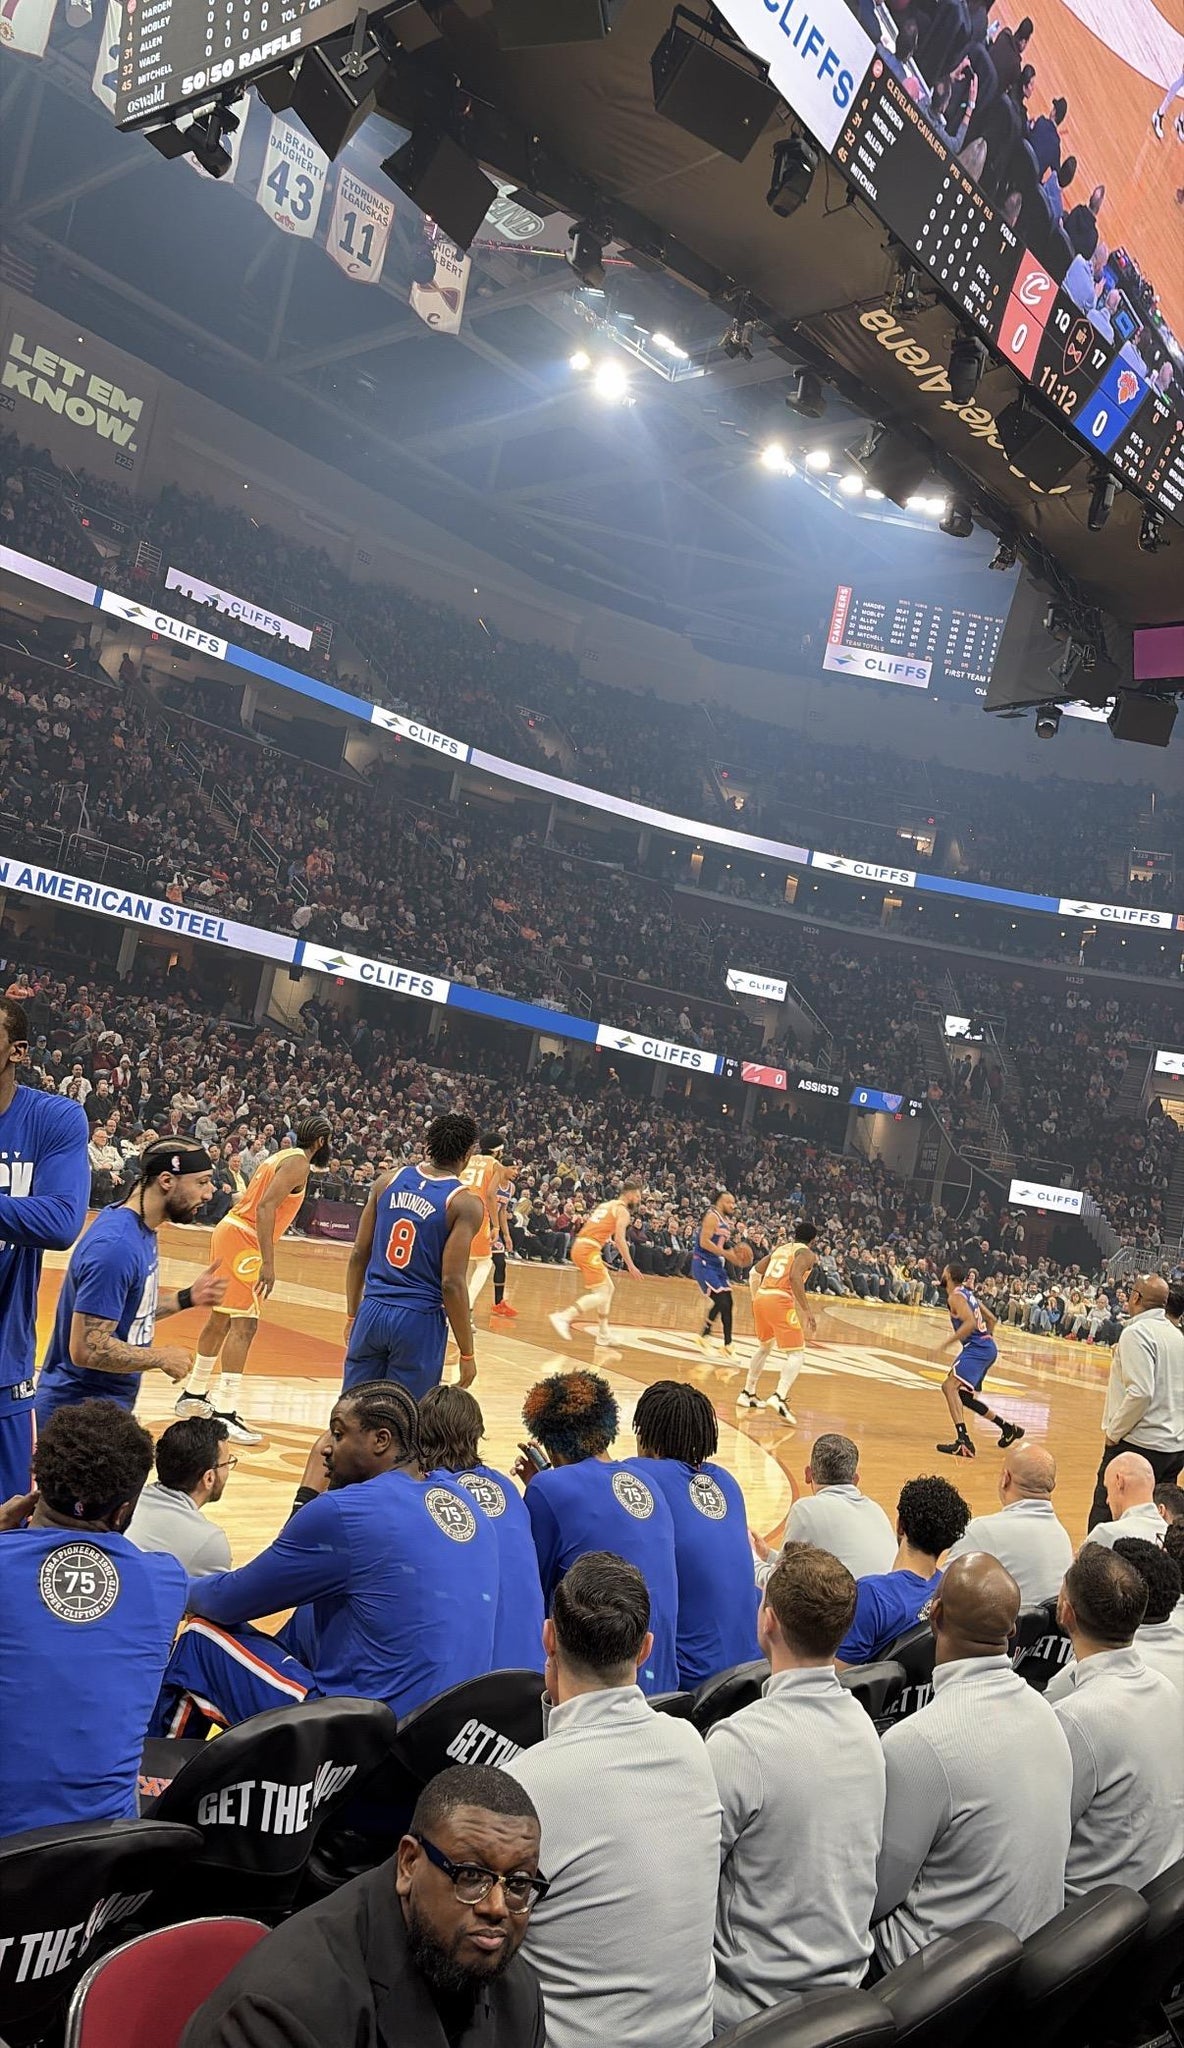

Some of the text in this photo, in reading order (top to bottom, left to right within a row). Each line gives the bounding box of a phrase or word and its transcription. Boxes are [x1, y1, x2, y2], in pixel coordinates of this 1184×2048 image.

[142, 0, 172, 20] HARDEN
[281, 8, 296, 23] TOL
[127, 16, 171, 41] 4 MOBLEY
[124, 48, 133, 59] 31
[140, 35, 162, 52] ALLEN
[238, 27, 302, 70] RAFFLE
[121, 79, 132, 91] 45
[138, 64, 172, 85] MITCHELL
[122, 63, 133, 76] 32
[138, 52, 161, 69] WADE
[127, 82, 166, 113] oswald
[880, 95, 904, 131] HARDEN
[887, 78, 919, 124] CLEVELAND
[917, 119, 947, 161] CAVALIERS
[872, 112, 897, 146] MOBLEY
[285, 131, 314, 159] BRAD
[864, 130, 884, 157] ALLEN
[270, 135, 324, 181] DAUGHERTY
[858, 145, 877, 173] WADE
[266, 159, 315, 221] 43
[850, 162, 878, 201] MITCHELL
[340, 188, 388, 227] ILGAUSKAS
[342, 175, 390, 216] ZYDRUNAS
[339, 211, 375, 267] 11
[1000, 223, 1017, 248] FOULS
[434, 254, 464, 279] LBERT
[963, 296, 975, 313] TOL
[979, 315, 989, 329] CH
[1054, 308, 1070, 333] 1Q
[860, 308, 951, 391] Arena
[1011, 323, 1028, 353] 0
[1091, 348, 1107, 370] 17
[9, 333, 144, 422] LET EM
[1039, 365, 1077, 415] 11:12
[1, 361, 138, 452] KNOW.
[1153, 399, 1170, 418] FOULS
[1091, 410, 1108, 437] 0
[1113, 452, 1123, 468] TOL
[1158, 491, 1176, 511] TOWNS
[230, 601, 282, 632] CLIFFS
[831, 588, 849, 643] CAVALIERS
[858, 624, 874, 632] WADE
[860, 617, 878, 625] ALLEN
[154, 616, 220, 653] CLIFFS
[857, 631, 884, 642] MITCHELL
[864, 658, 927, 680] CLIFFS
[944, 668, 965, 678] FIRST
[966, 672, 986, 682] TEAM
[408, 724, 459, 755] CLIFFS
[853, 864, 910, 883] CLIFFS
[15, 868, 229, 942] AMERICAN STEEL
[1100, 907, 1160, 924] CLIFFS
[360, 963, 434, 996] CLIFFS
[749, 980, 784, 994] CLIFFS
[641, 1041, 702, 1067] CLIFFS
[774, 1074, 783, 1085] 0
[798, 1079, 840, 1096] ASSISTS
[859, 1091, 868, 1104] 0
[389, 1191, 437, 1220] ANUNOBY
[1037, 1192, 1079, 1206] CLIFFS
[385, 1217, 417, 1269] 8
[471, 1487, 492, 1502] 75
[624, 1487, 642, 1502] 75
[699, 1492, 717, 1505] 75
[440, 1506, 462, 1522] 75
[45, 1545, 113, 1576] NBA PIONEERS 1950
[43, 1576, 61, 1611] COOPER
[64, 1571, 96, 1594] 75
[102, 1579, 116, 1607] LLOYD
[64, 1605, 100, 1618] CLIFTON
[446, 1718, 526, 1769] GET TH
[197, 1780, 256, 1827] GET
[260, 1780, 313, 1835] THE
[15, 1922, 85, 1983] THE
